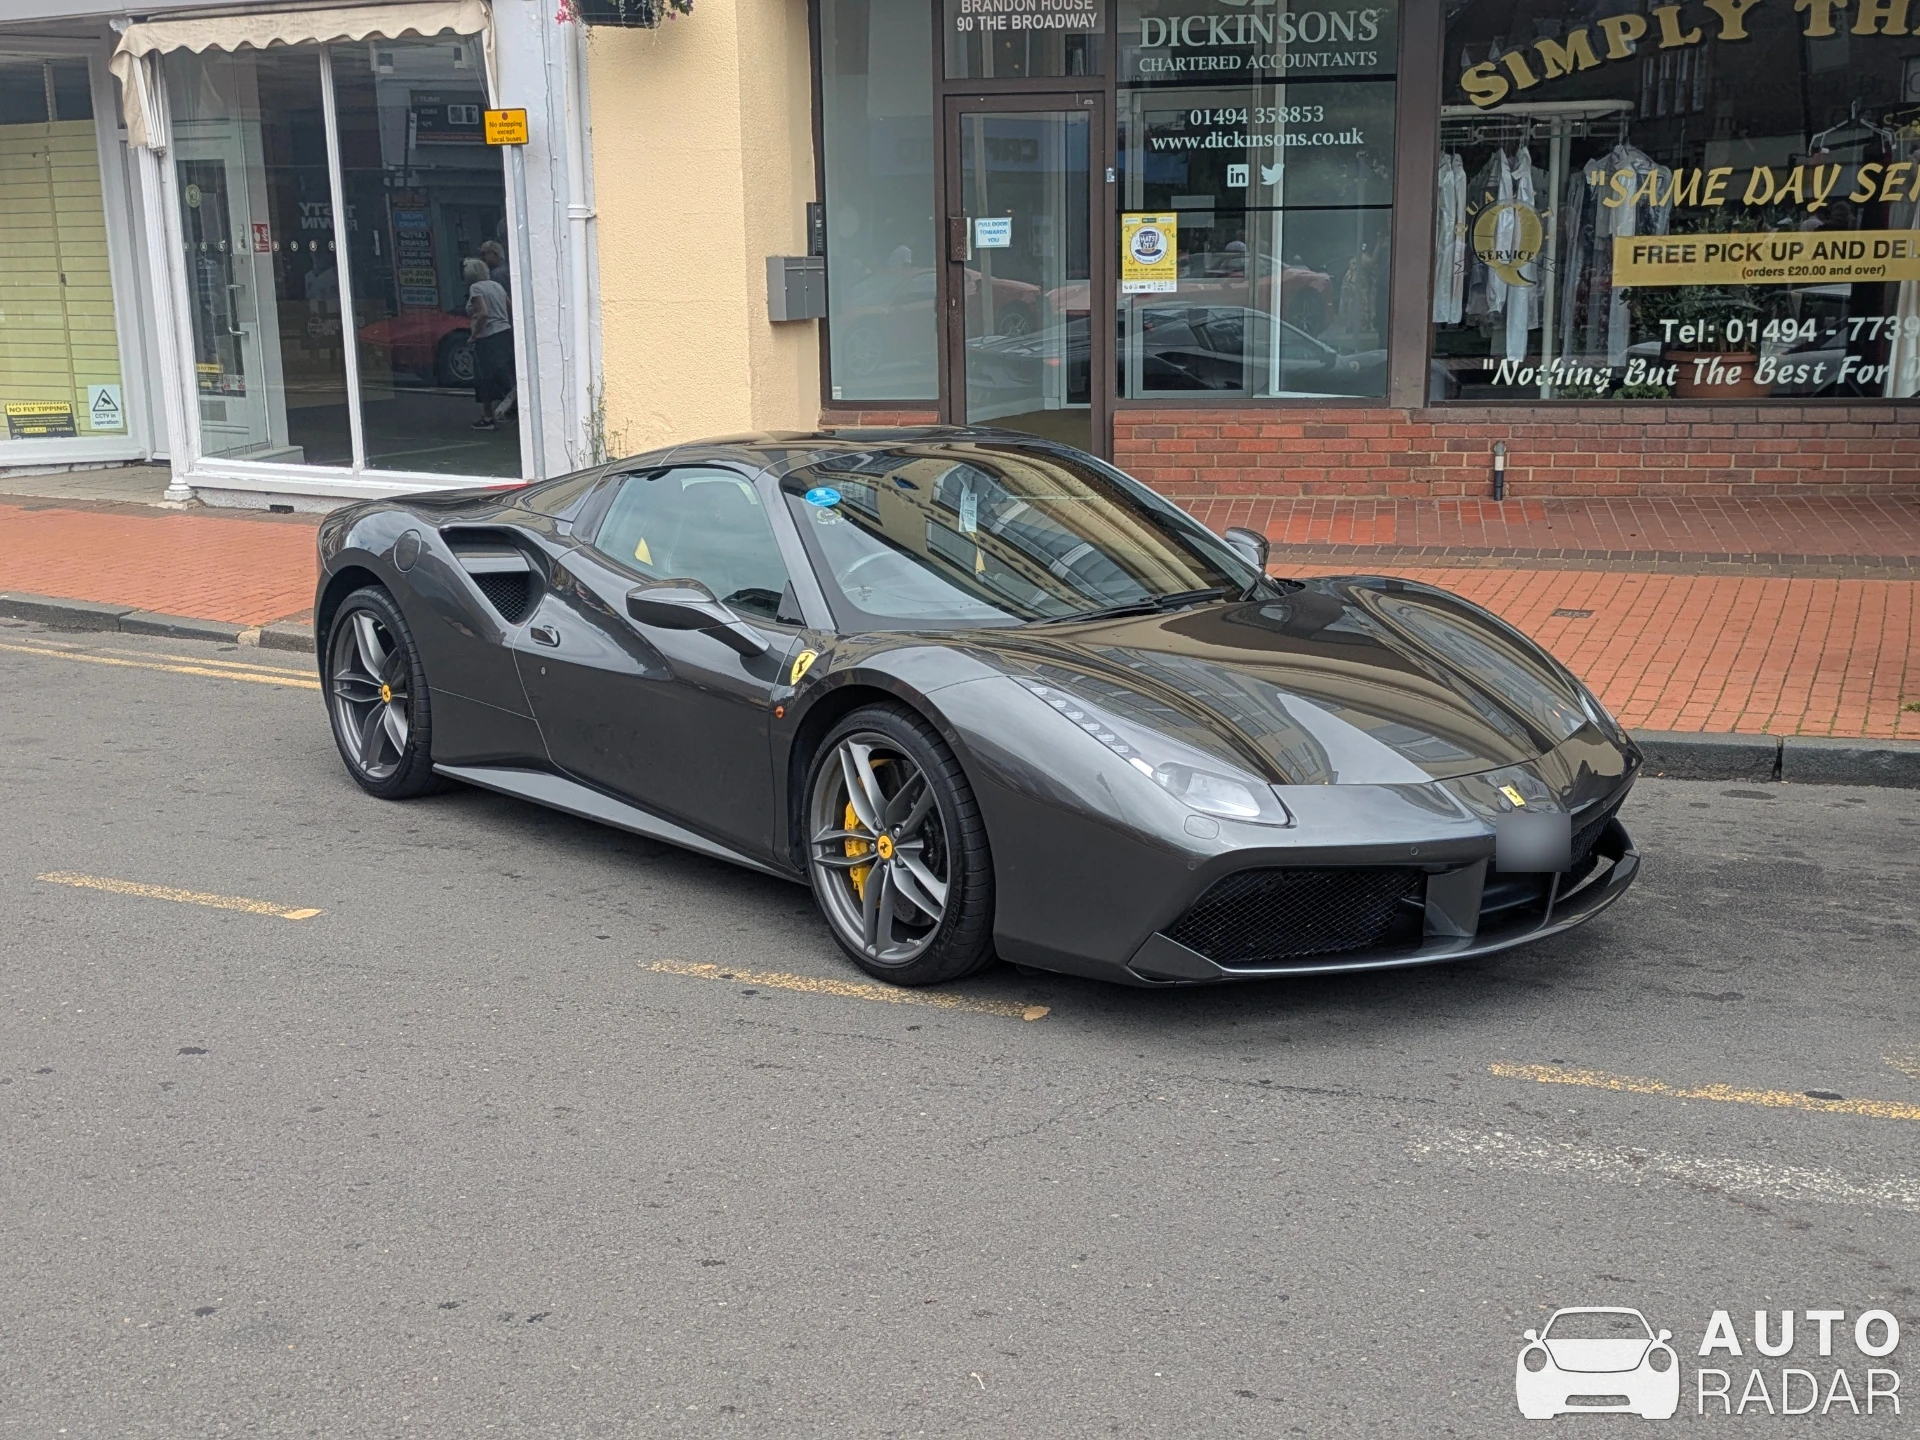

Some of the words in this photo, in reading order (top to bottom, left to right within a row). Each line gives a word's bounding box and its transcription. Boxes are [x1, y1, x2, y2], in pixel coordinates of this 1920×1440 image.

[961, 0, 1036, 14] BRANDON
[1041, 0, 1094, 11] HOUSE
[956, 16, 973, 32] 90
[977, 15, 1007, 31] THE
[1011, 12, 1098, 30] BROADWAY
[1138, 10, 1379, 48] DICKINSONS
[1138, 55, 1242, 73] CHARTERED
[1245, 51, 1378, 70] ACCOUNTANTS
[1460, 0, 1756, 107] SIMPLY
[1794, 0, 1920, 36] TH
[498, 120, 523, 129] stopping
[1189, 108, 1249, 126] 01494
[1254, 105, 1325, 124] 358853
[1150, 127, 1365, 150] www.dickinsons.co.uk
[1742, 164, 1842, 213] DAY
[1478, 249, 1535, 261] SERVICE
[1632, 244, 1697, 265] FREE
[1704, 242, 1763, 263] PICK
[1771, 241, 1805, 261] UP
[1811, 240, 1865, 261] AND
[1741, 266, 1785, 280] (orders
[1787, 265, 1826, 277] £20.00
[1829, 264, 1852, 277] and
[1854, 264, 1886, 278] over)
[1659, 318, 1715, 344] Tel:
[1725, 317, 1818, 344] 01494
[1623, 357, 1680, 387] But
[1692, 355, 1743, 386] The
[1753, 356, 1828, 386] Best
[1836, 355, 1890, 385] For
